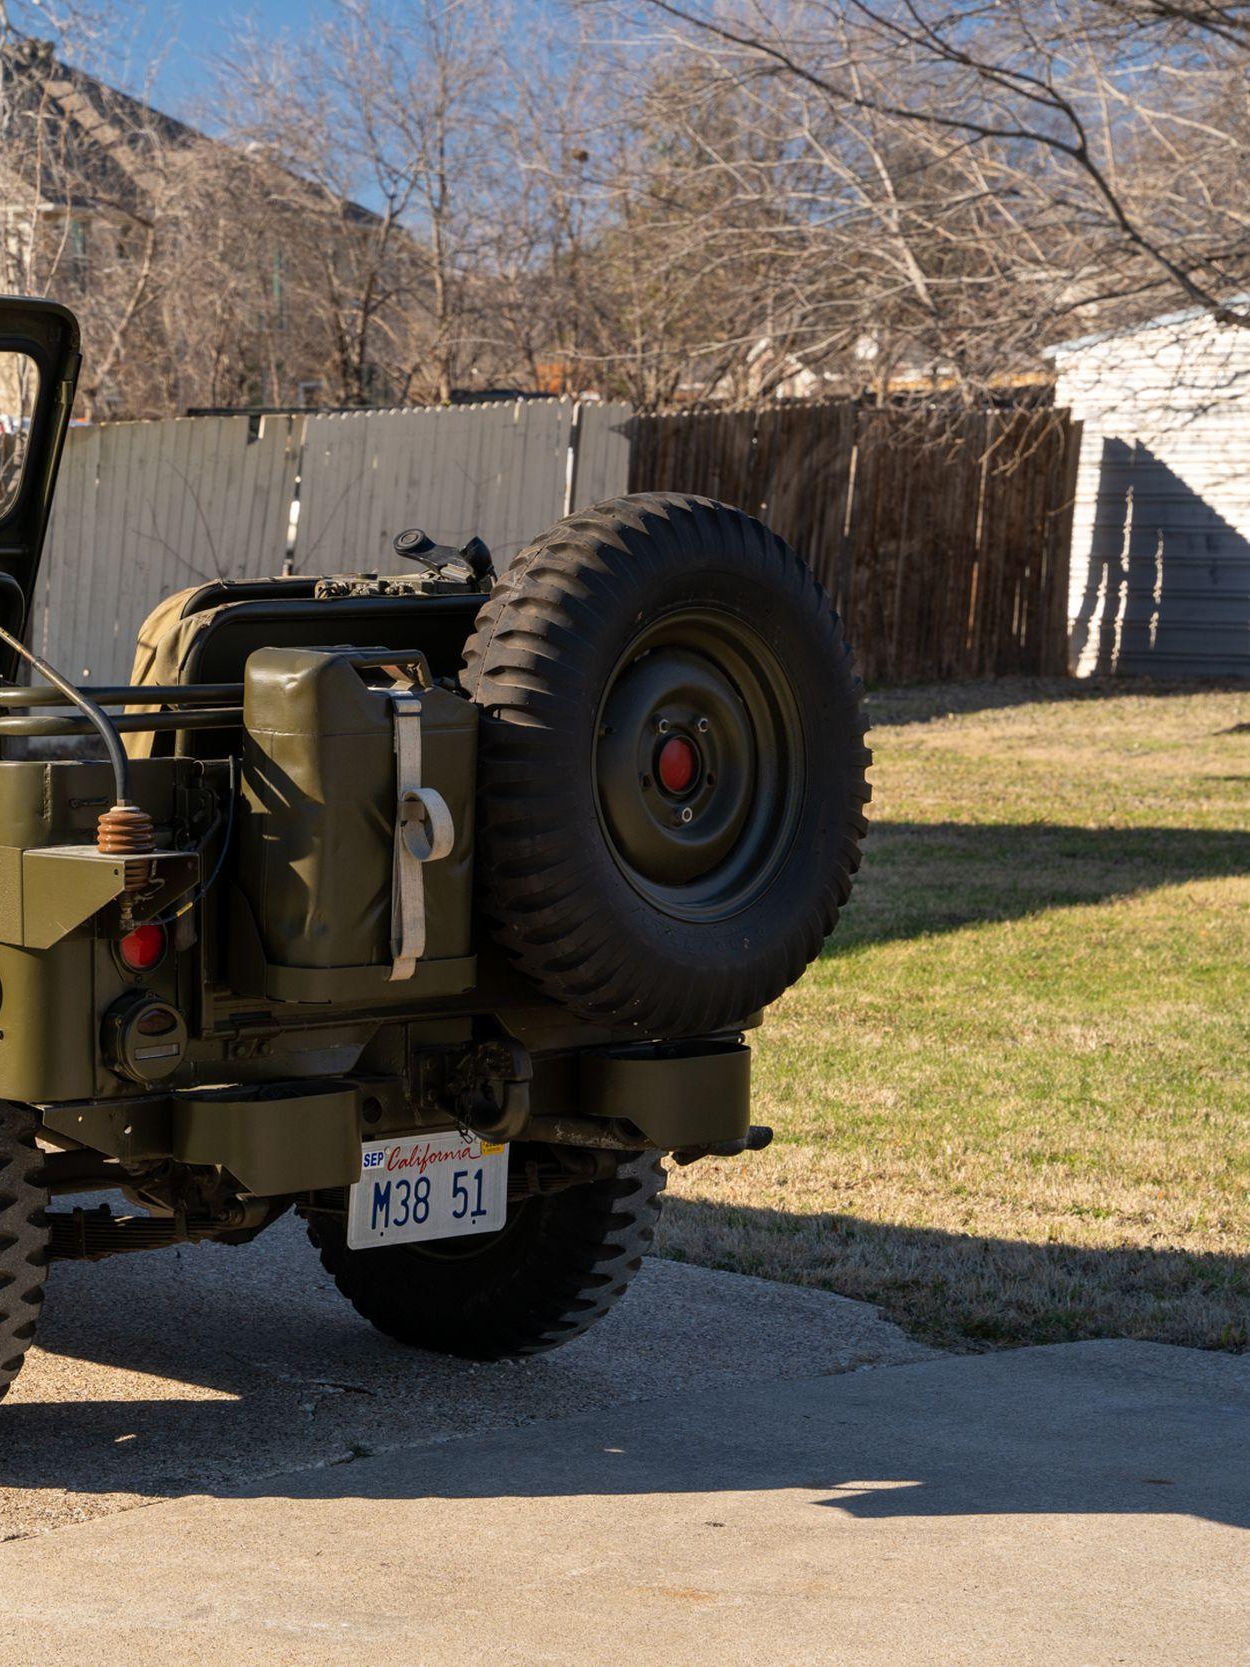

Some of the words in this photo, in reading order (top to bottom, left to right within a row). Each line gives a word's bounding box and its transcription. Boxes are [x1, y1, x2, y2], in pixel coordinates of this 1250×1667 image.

[363, 1151, 384, 1168] SEP
[386, 1142, 482, 1175] California
[370, 1176, 431, 1230] M38
[452, 1168, 487, 1219] 51
